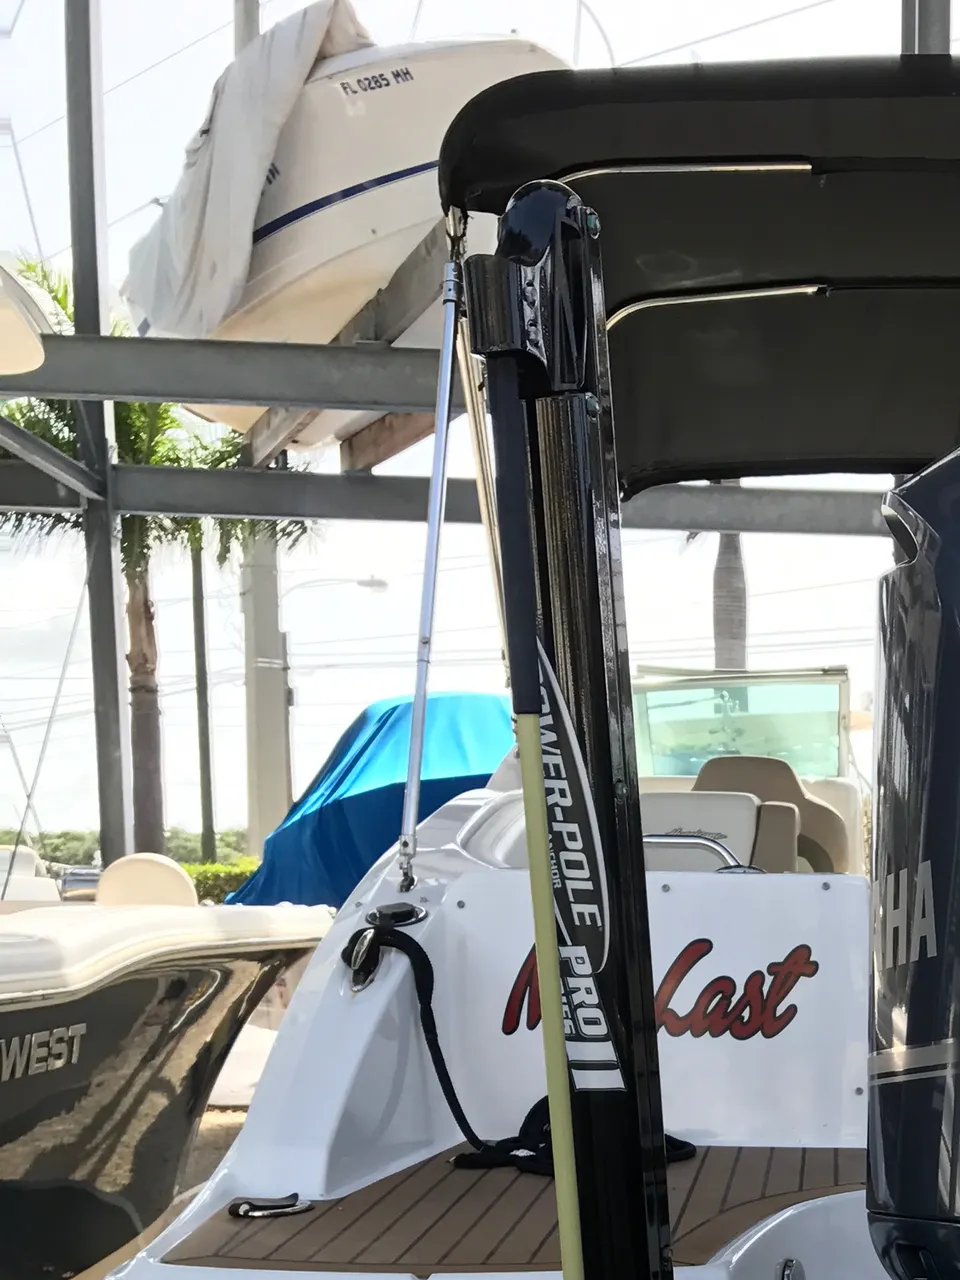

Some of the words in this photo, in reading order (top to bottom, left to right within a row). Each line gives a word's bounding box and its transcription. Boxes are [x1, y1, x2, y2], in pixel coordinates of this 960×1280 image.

[340, 81, 358, 95] FL
[356, 73, 391, 92] 0285
[558, 945, 609, 1038] PRO
[0, 1022, 87, 1082] WEST
